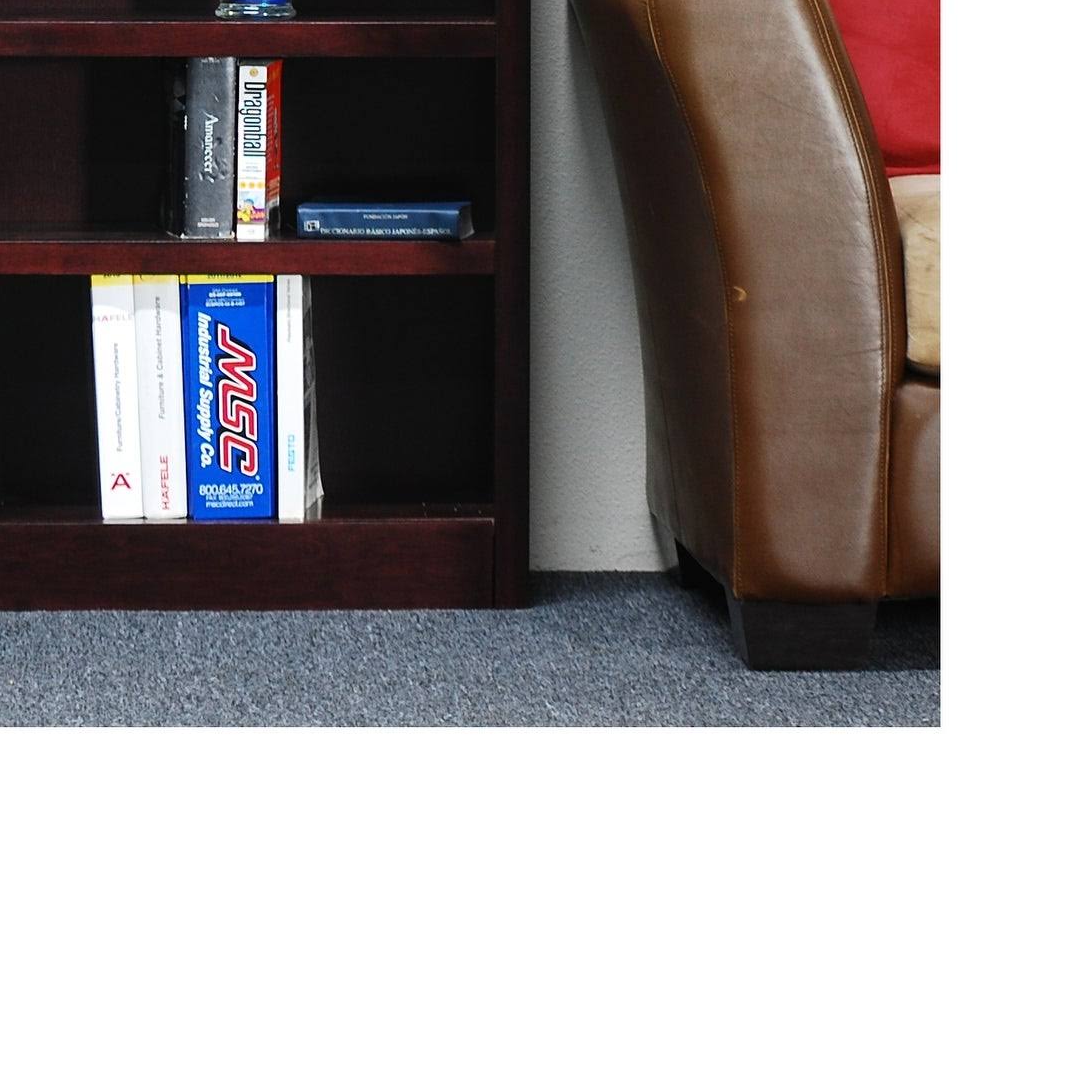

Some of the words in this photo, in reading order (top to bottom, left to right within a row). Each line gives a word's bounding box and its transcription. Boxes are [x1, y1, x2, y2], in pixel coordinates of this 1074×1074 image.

[204, 112, 220, 173] Amanecer
[239, 81, 267, 157] Dragonball
[154, 296, 162, 337] Hardware
[197, 311, 214, 385] Industrial
[197, 387, 214, 442] Supply
[217, 322, 259, 477] MSC
[200, 442, 215, 468] Co.
[287, 434, 296, 472] FESTO
